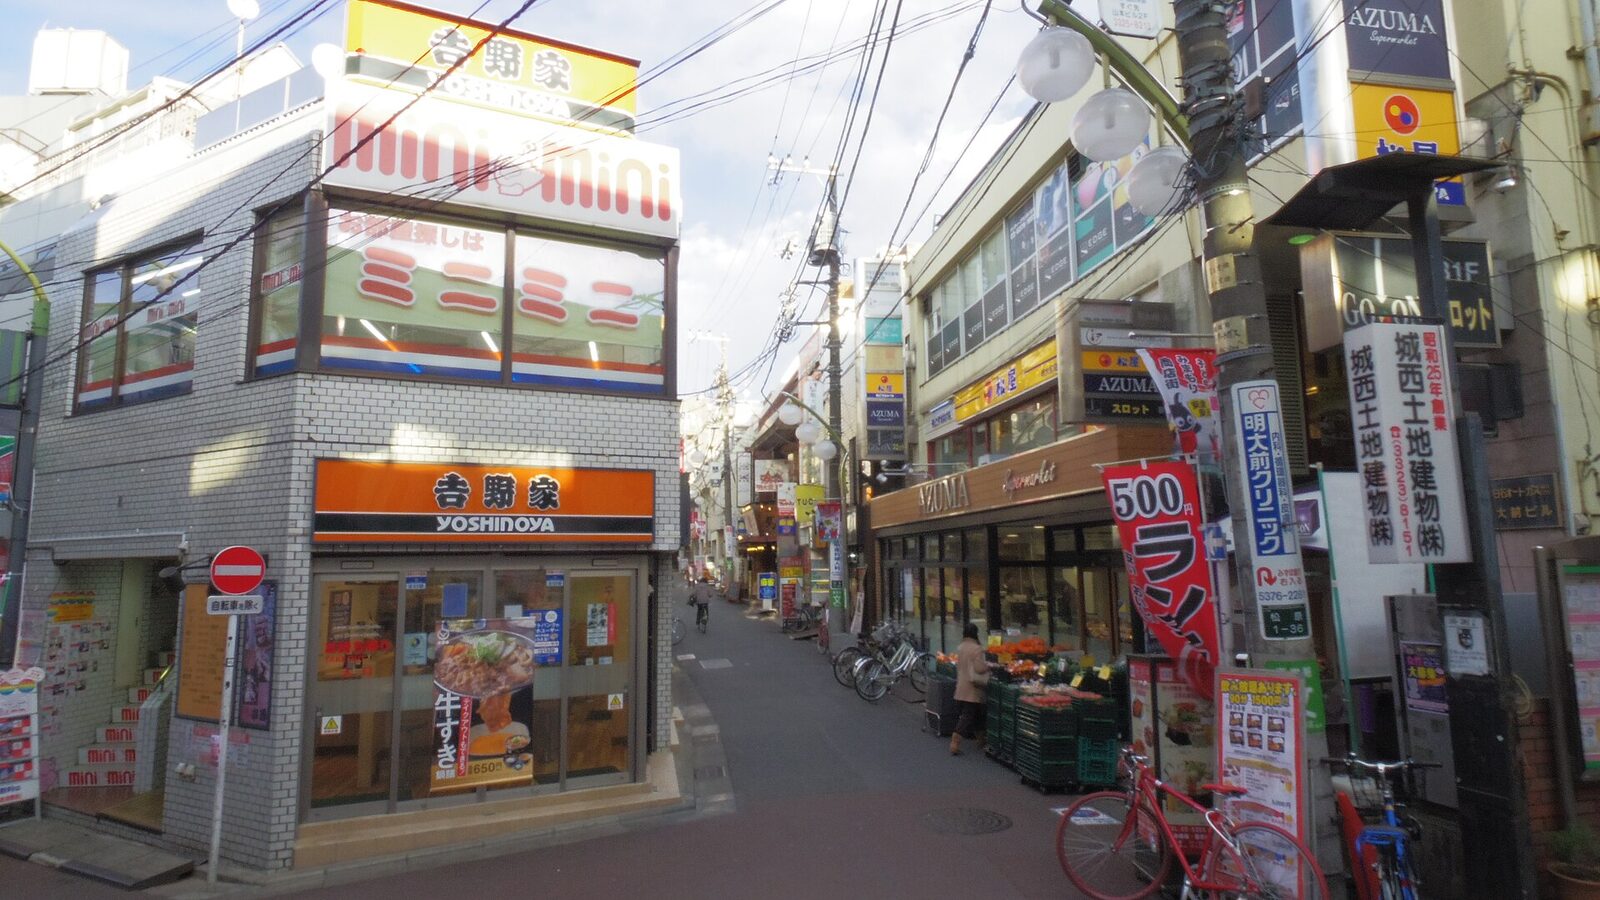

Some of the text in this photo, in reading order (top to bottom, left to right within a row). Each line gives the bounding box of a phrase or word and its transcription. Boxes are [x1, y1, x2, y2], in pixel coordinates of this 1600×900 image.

[1348, 6, 1436, 35] AZUMA
[1369, 30, 1417, 45] Supermarket
[429, 27, 572, 92] 吉野家
[359, 247, 639, 328] ミニミニ
[1159, 357, 1179, 389] 商店街
[1098, 377, 1159, 393] AZUMA
[1111, 404, 1149, 415] スロット
[433, 472, 560, 511] 吉野家
[1244, 414, 1282, 555] 明大前クリニック
[436, 516, 555, 532] YOSHINOYA
[211, 600, 258, 612] 自転車を除く
[1273, 624, 1304, 634] 1-36
[105, 728, 132, 742] mini
[87, 749, 115, 763] mini
[68, 771, 97, 785] mini
